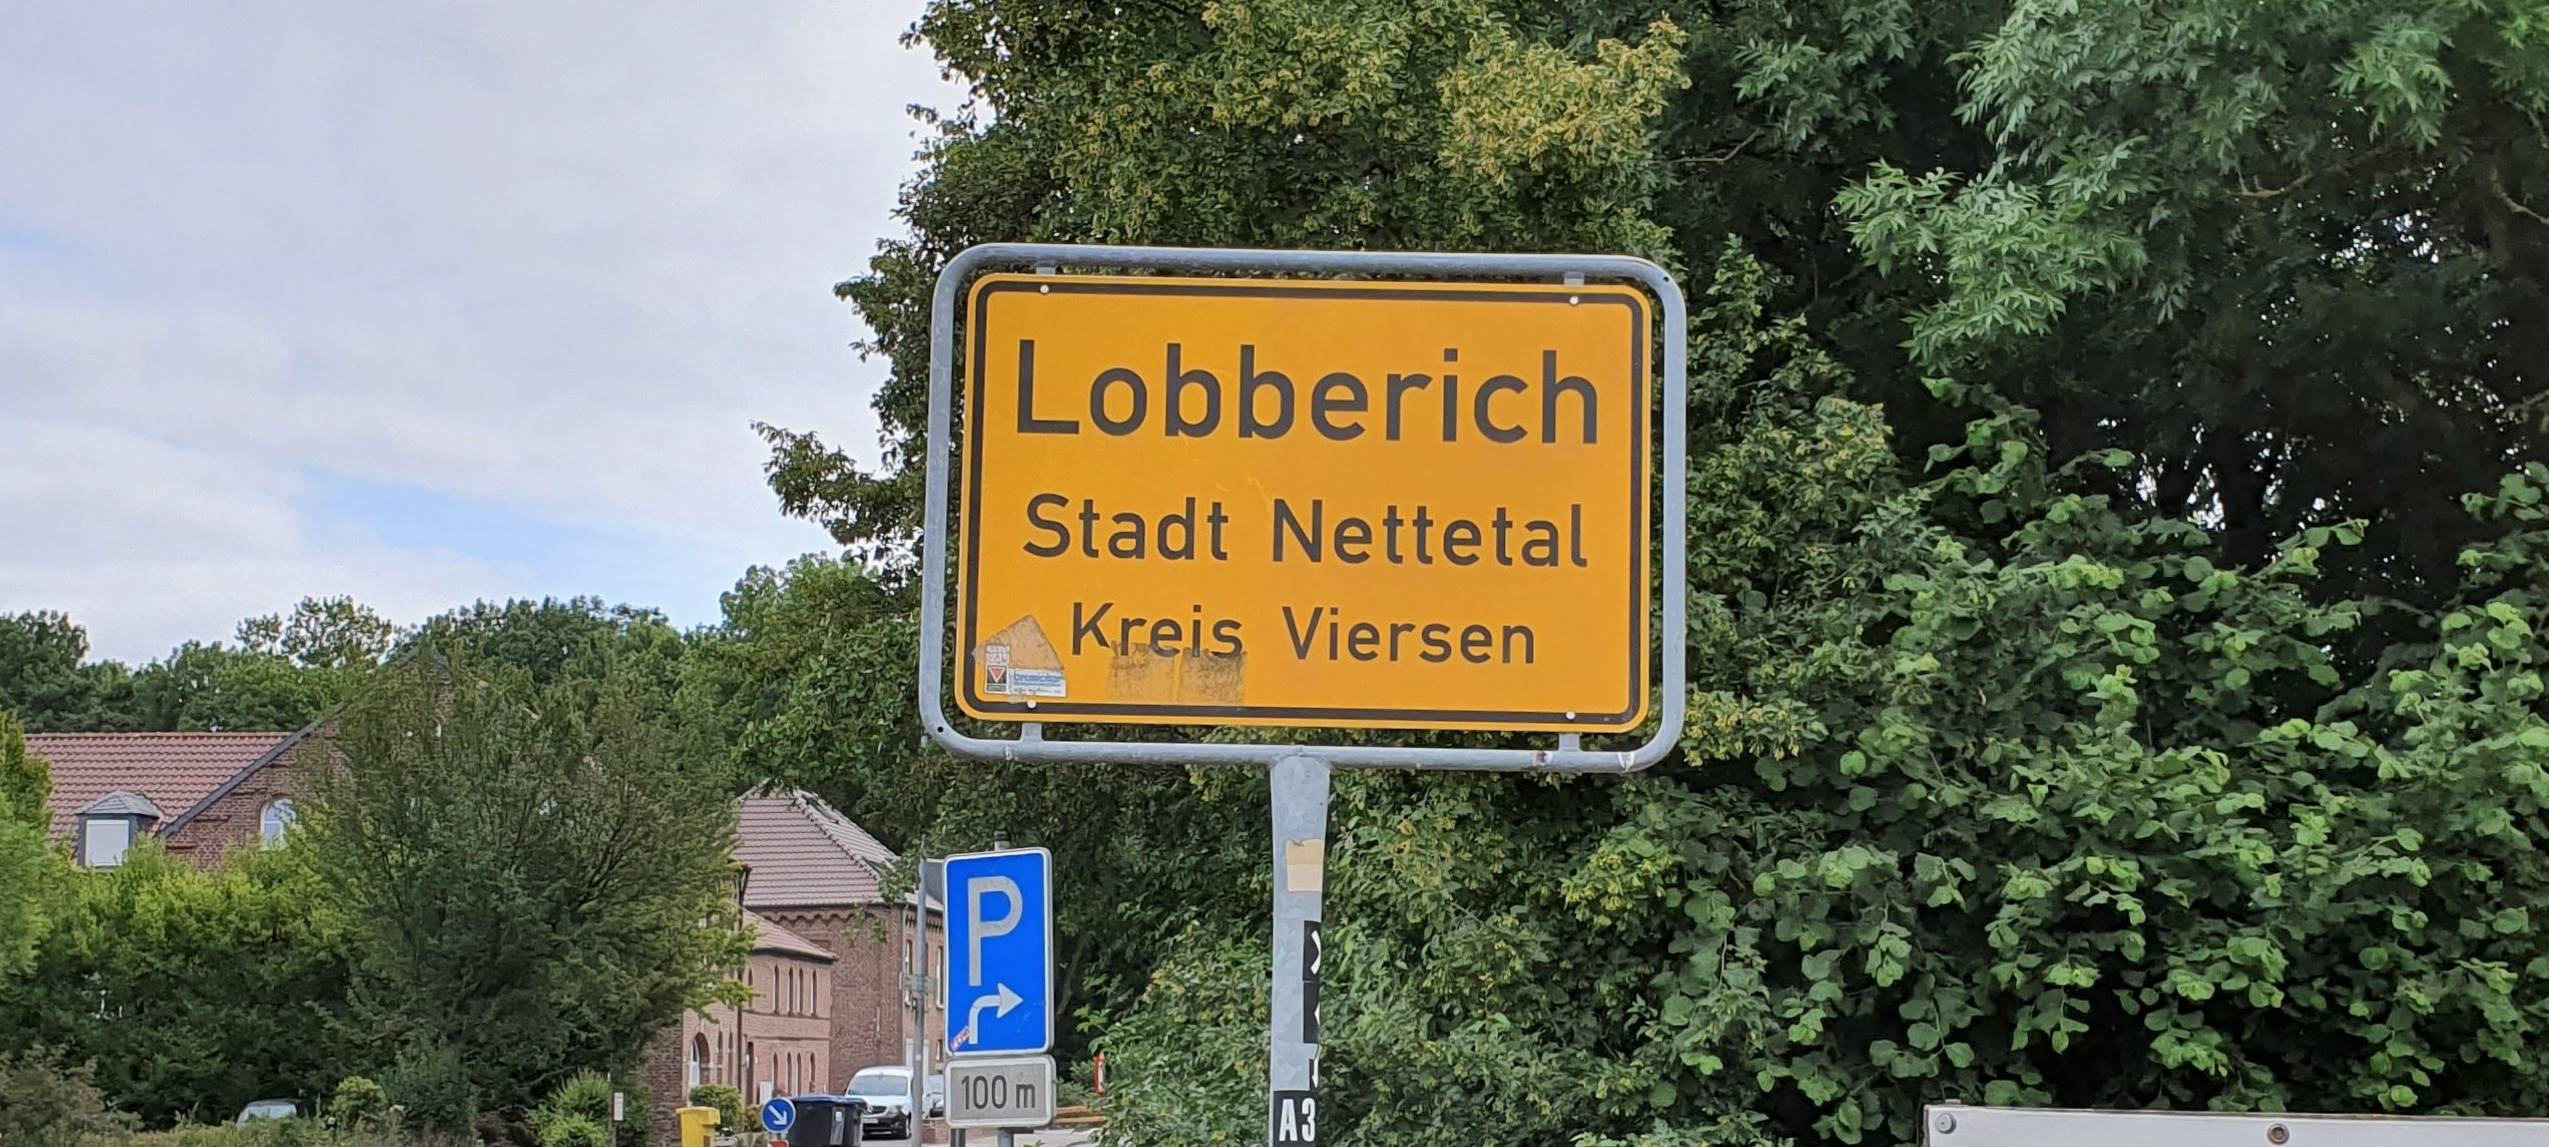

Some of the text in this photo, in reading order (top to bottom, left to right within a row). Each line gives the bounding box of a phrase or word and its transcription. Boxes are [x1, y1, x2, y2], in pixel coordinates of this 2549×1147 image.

[1016, 338, 1598, 444] Lobberich
[1023, 493, 1588, 568] Stadt Nettetal
[1071, 601, 1534, 665] Kreis Viersen
[967, 875, 1024, 988] P
[961, 1074, 1036, 1110] 100 m
